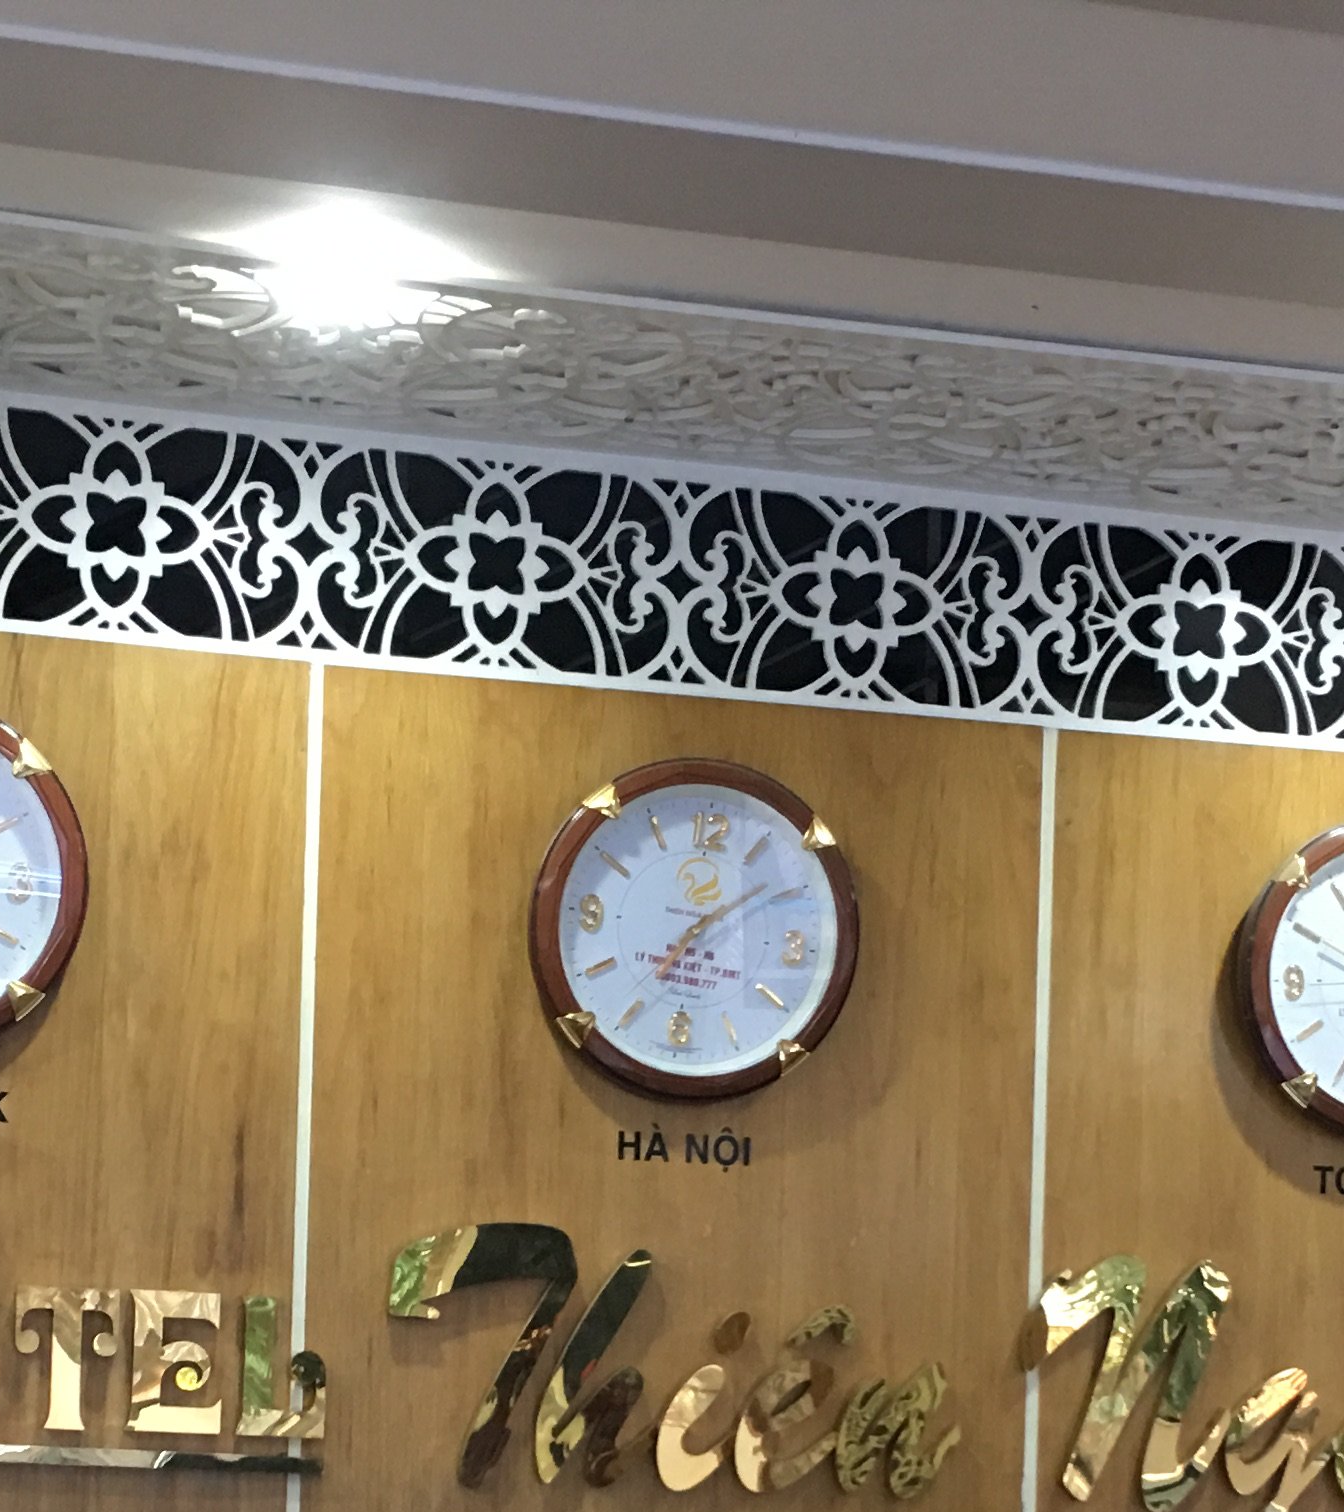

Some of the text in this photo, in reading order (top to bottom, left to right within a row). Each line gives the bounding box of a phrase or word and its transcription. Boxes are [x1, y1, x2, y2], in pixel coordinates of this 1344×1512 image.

[691, 810, 731, 852] 12
[579, 893, 604, 934] 9
[782, 929, 805, 966] 3
[1283, 964, 1305, 1001] 9
[666, 1010, 693, 1047] 6
[617, 1123, 752, 1173] HÀ NỘI
[389, 1222, 961, 1500] Thiên
